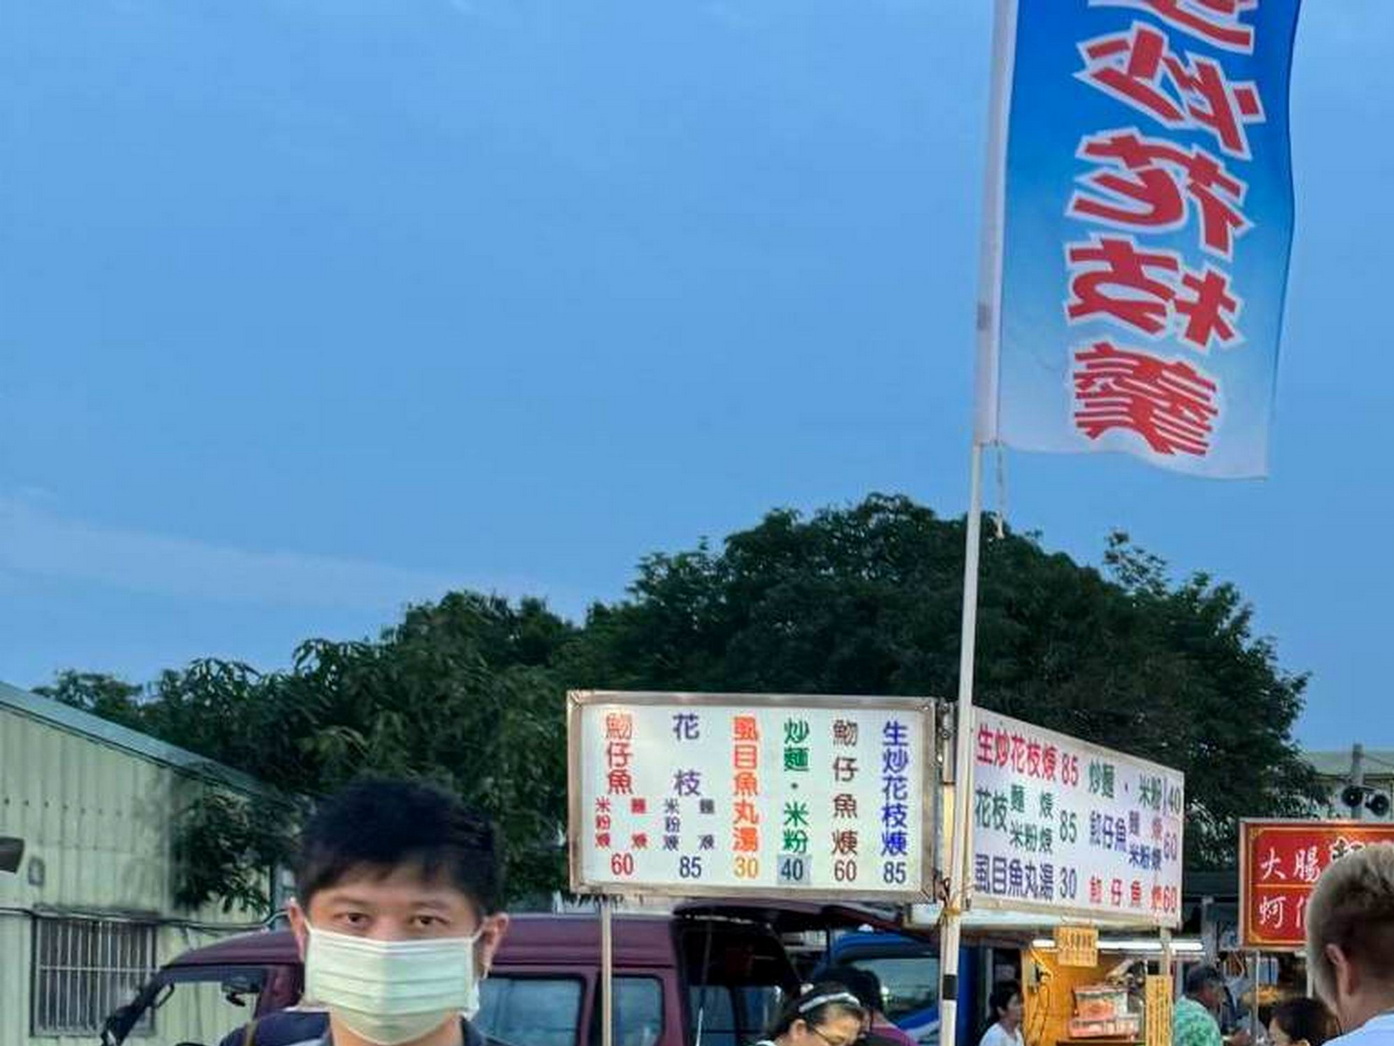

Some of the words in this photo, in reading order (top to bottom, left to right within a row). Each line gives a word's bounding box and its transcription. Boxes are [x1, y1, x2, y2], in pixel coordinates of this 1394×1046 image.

[673, 713, 701, 796] 花枝
[1061, 753, 1079, 786] 85
[975, 787, 1007, 832] 花枝
[1060, 810, 1078, 843] 85
[611, 853, 634, 875] 60
[680, 856, 702, 878] 85
[734, 856, 758, 878] 30
[781, 858, 803, 880] 40
[834, 860, 857, 882] 60
[883, 861, 906, 884] 85
[1260, 846, 1321, 882] 大腸
[1059, 867, 1078, 899] 30
